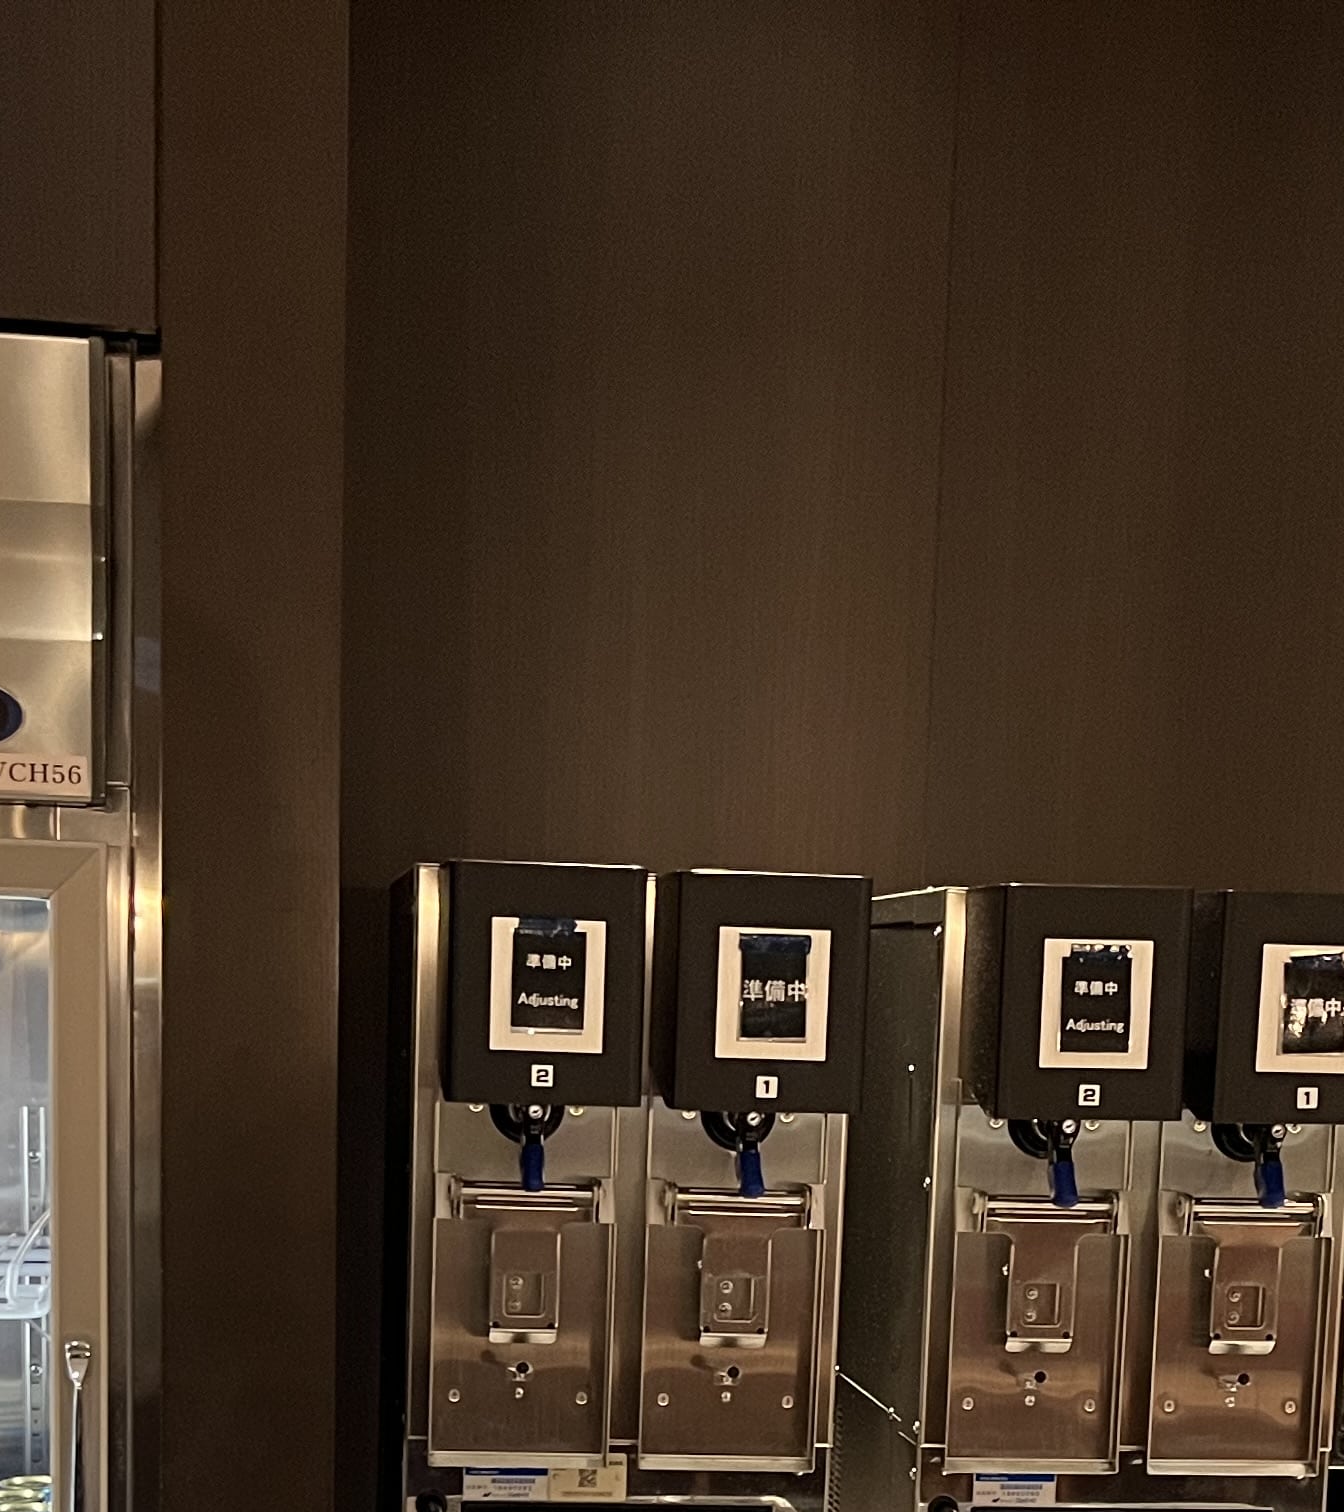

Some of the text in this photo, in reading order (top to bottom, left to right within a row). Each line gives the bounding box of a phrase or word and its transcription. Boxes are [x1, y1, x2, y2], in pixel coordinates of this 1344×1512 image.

[742, 980, 805, 1002] 準備中
[517, 992, 579, 1010] Adjusting
[1065, 1018, 1125, 1034] Adjusting
[536, 1069, 549, 1083] 2
[763, 1080, 770, 1094] 1
[1083, 1088, 1096, 1102] 2
[1303, 1091, 1310, 1105] 1
